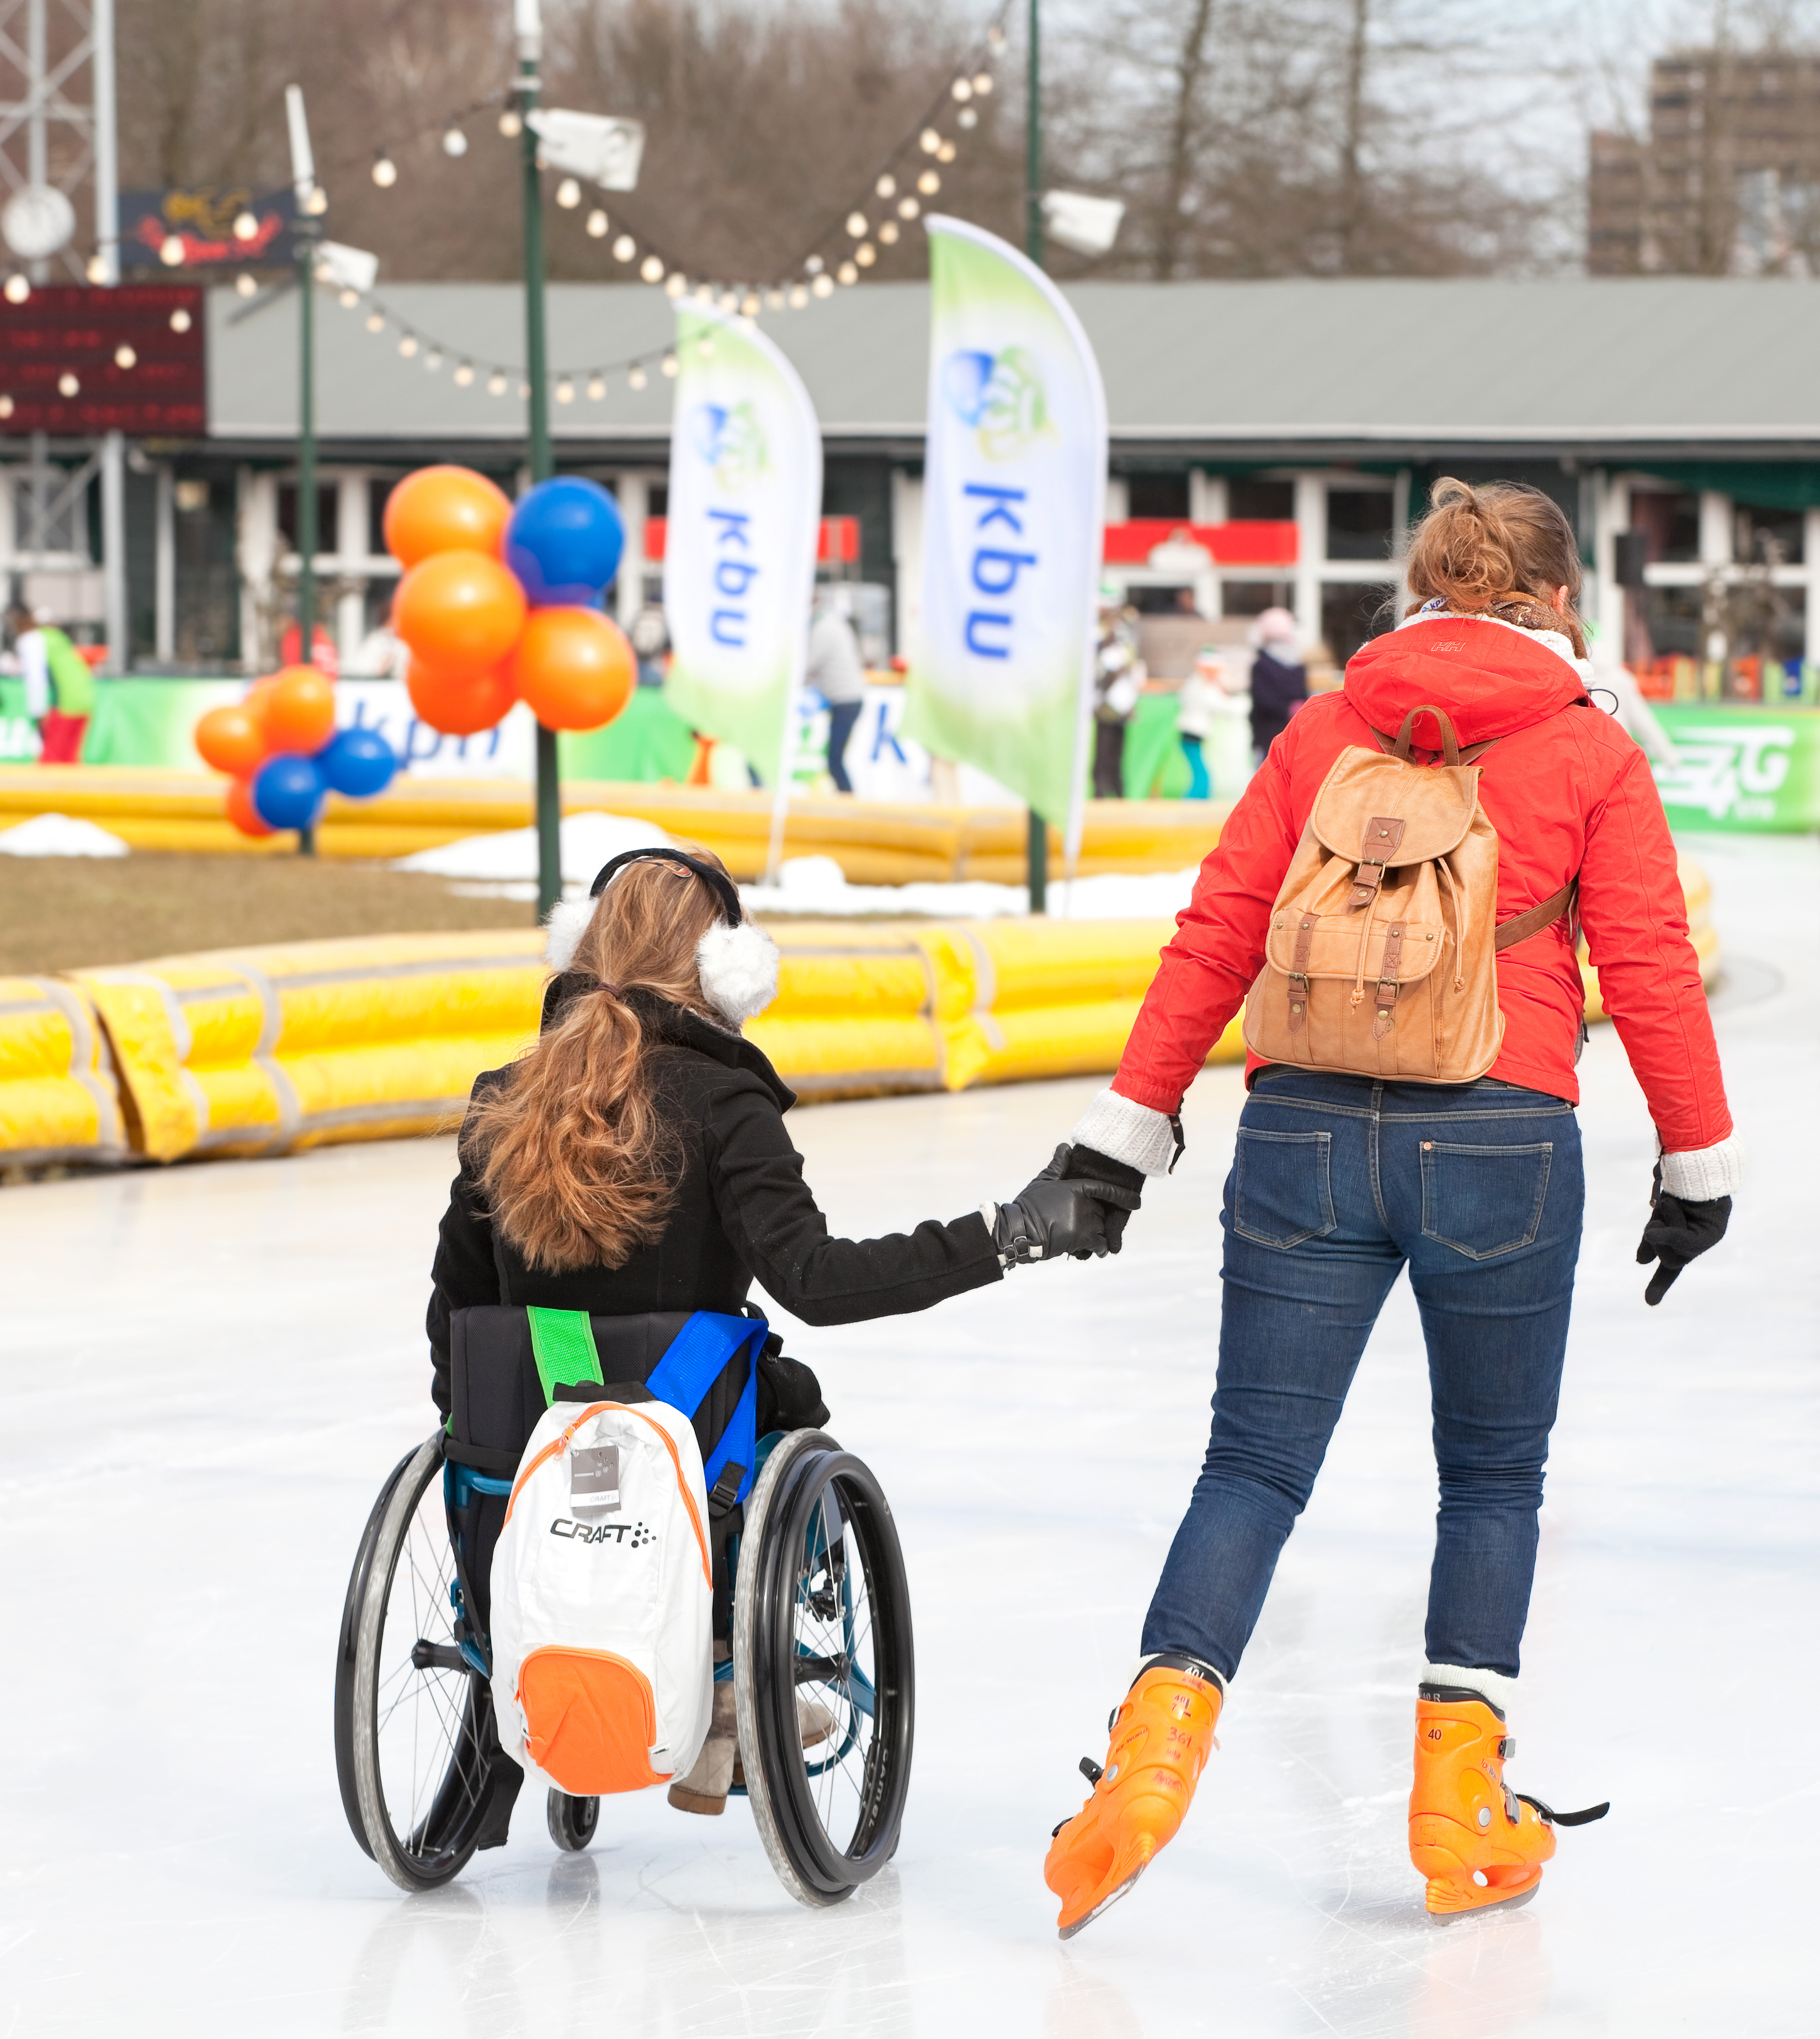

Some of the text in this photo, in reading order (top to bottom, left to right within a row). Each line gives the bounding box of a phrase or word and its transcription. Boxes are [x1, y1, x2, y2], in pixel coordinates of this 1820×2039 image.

[1431, 641, 1466, 651] HH
[589, 1494, 611, 1503] CRAFT
[550, 1518, 631, 1544] CRAFT
[1433, 1693, 1441, 1702] R
[1428, 1729, 1442, 1740] 40
